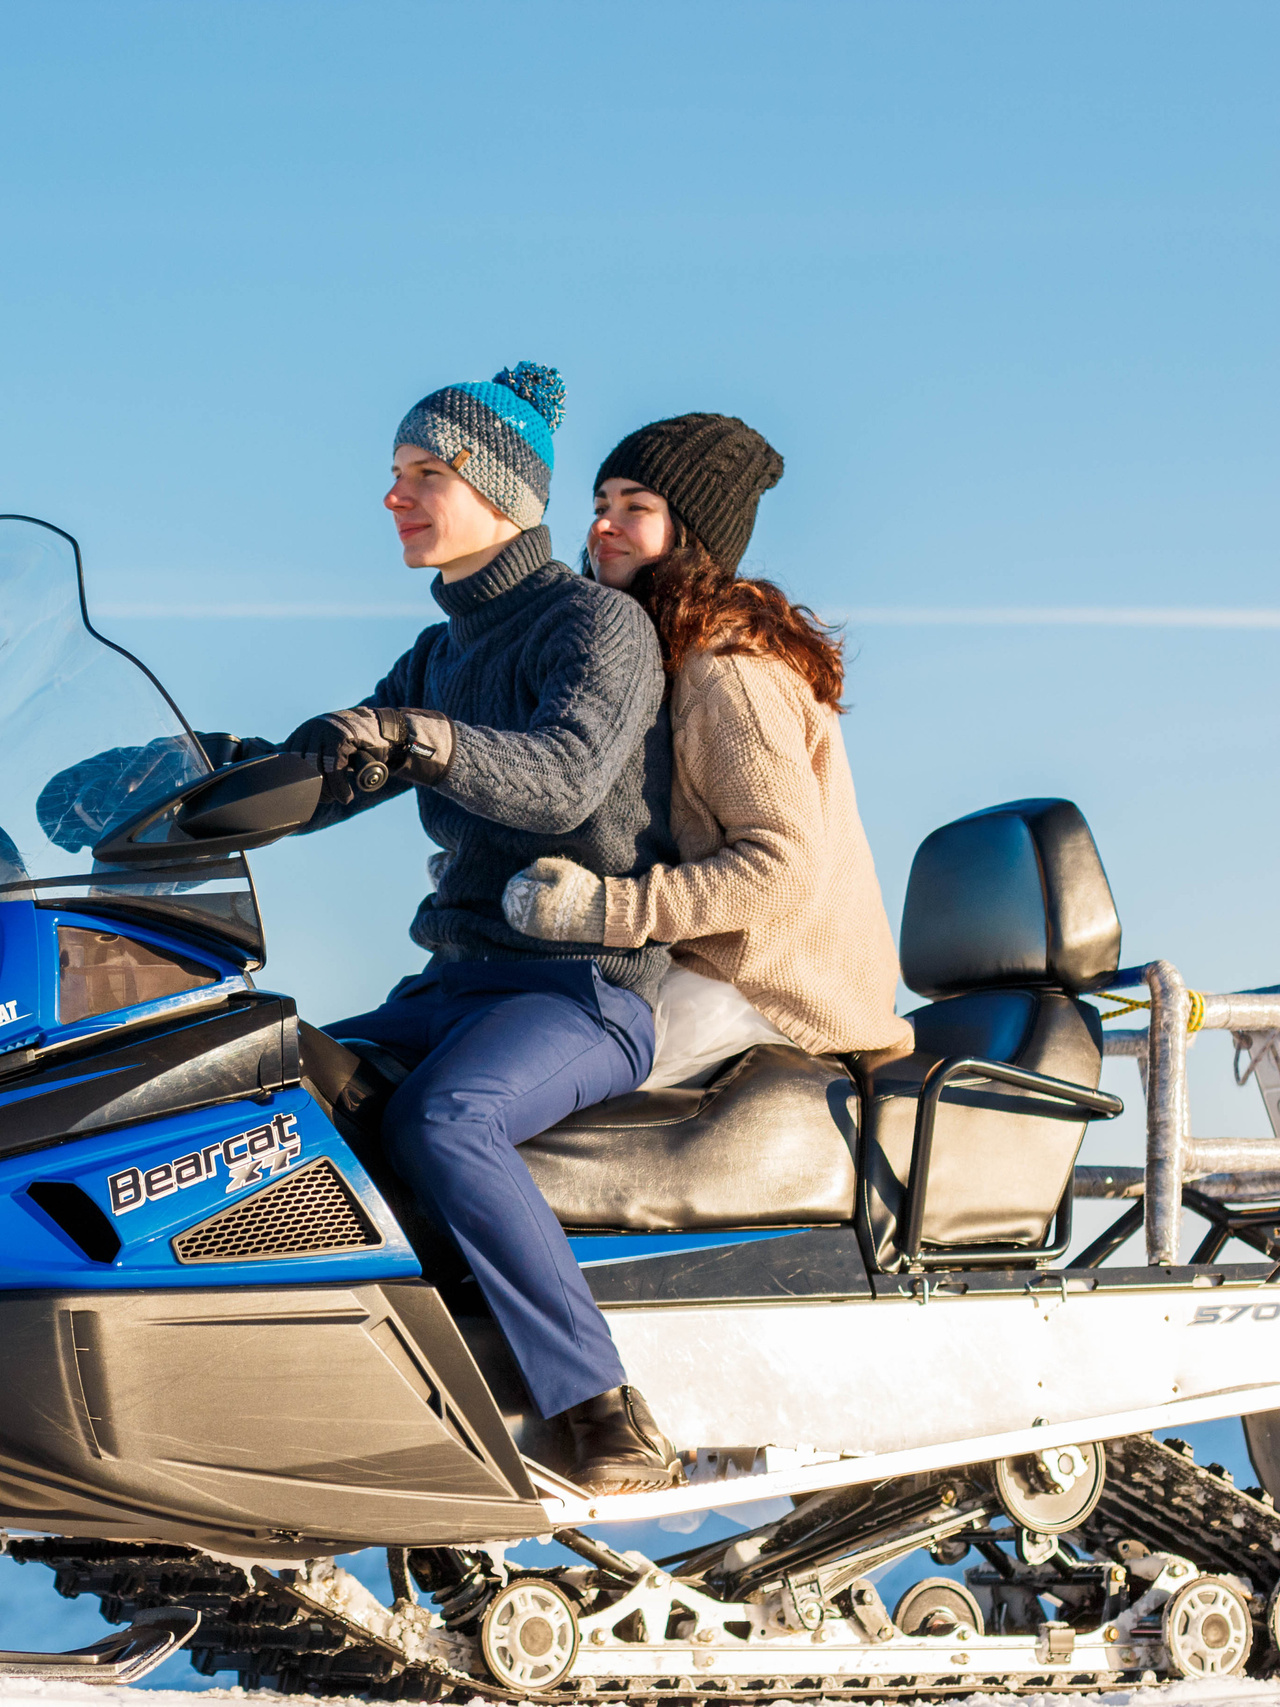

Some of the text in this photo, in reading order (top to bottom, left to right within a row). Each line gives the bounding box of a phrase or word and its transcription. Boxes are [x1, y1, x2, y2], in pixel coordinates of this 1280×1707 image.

[107, 1113, 301, 1216] Bearcat
[225, 1143, 301, 1194] XT
[1186, 1302, 1280, 1326] 570
